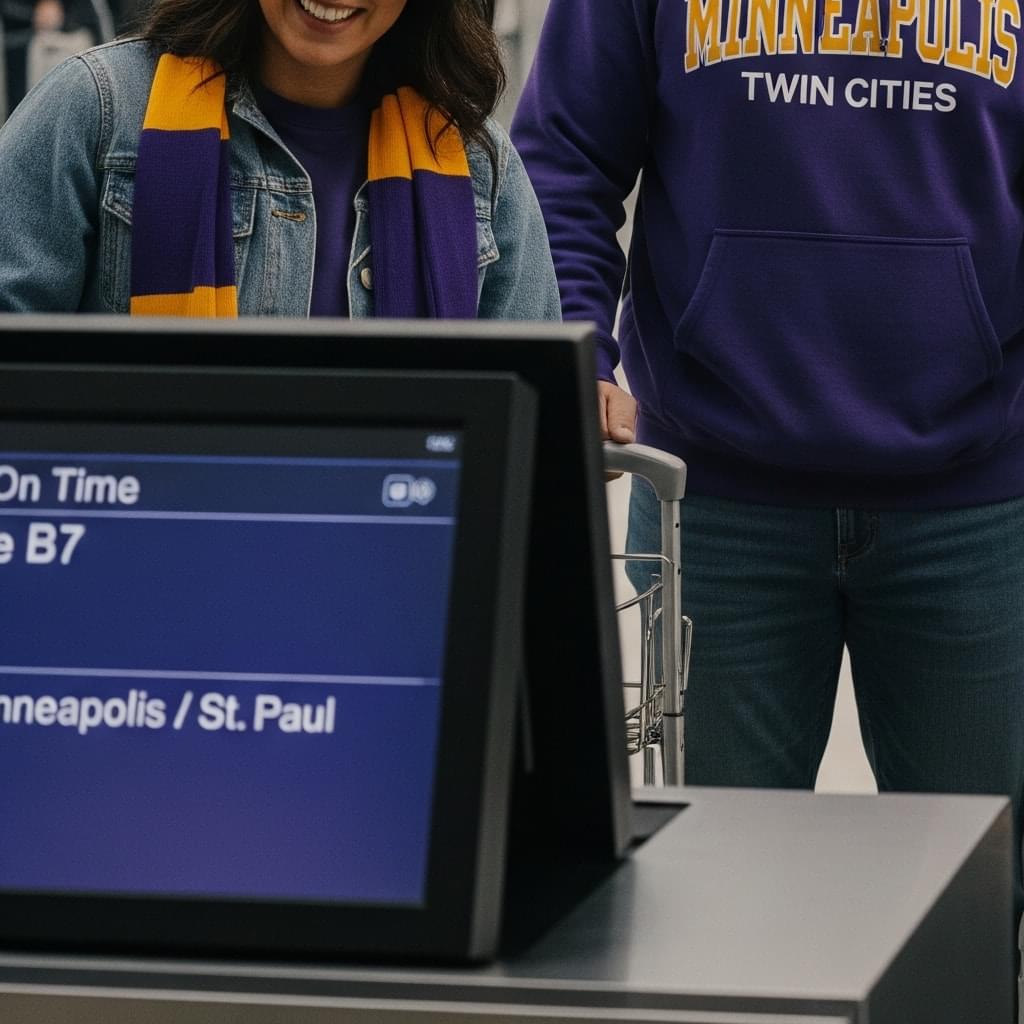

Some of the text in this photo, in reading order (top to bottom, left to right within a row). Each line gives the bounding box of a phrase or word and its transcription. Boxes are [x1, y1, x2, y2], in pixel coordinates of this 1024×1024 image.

[742, 72, 957, 112] TWIN CITIES
[0, 465, 140, 504] On Time
[26, 522, 85, 565] B7
[173, 691, 193, 729] /
[198, 692, 246, 730] St.
[254, 694, 336, 733] Paul
